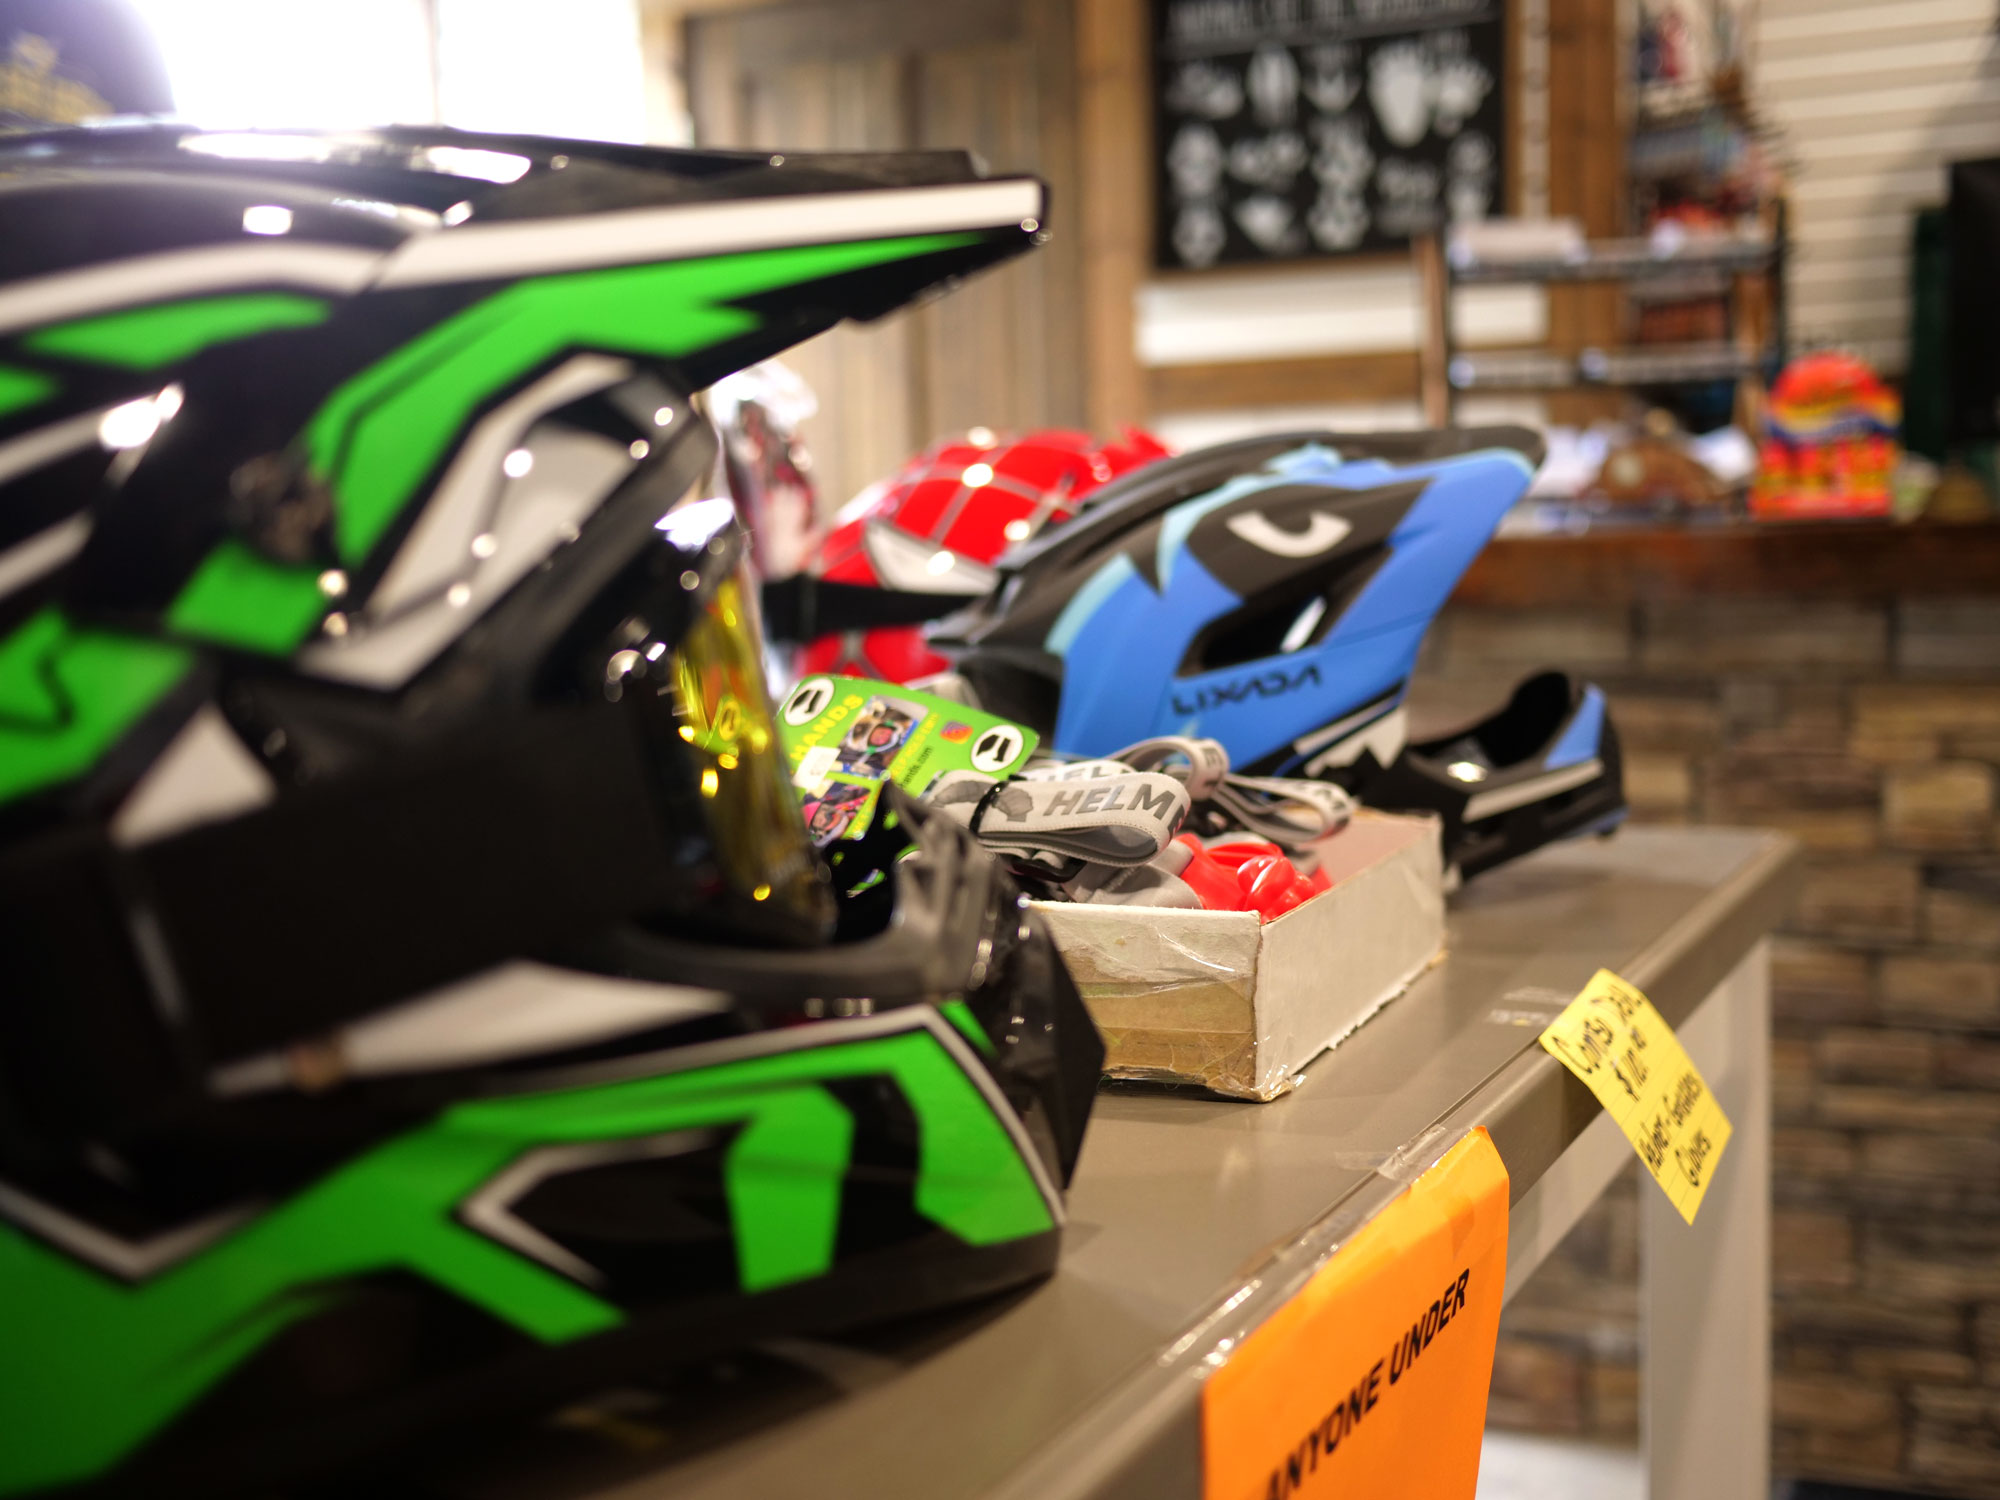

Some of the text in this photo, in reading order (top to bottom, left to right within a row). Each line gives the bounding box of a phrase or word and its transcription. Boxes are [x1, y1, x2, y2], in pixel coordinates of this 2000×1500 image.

[1172, 664, 1322, 716] LIXADA
[789, 694, 864, 761] HANDS
[1265, 1267, 1471, 1500] ANYONE UNDER
